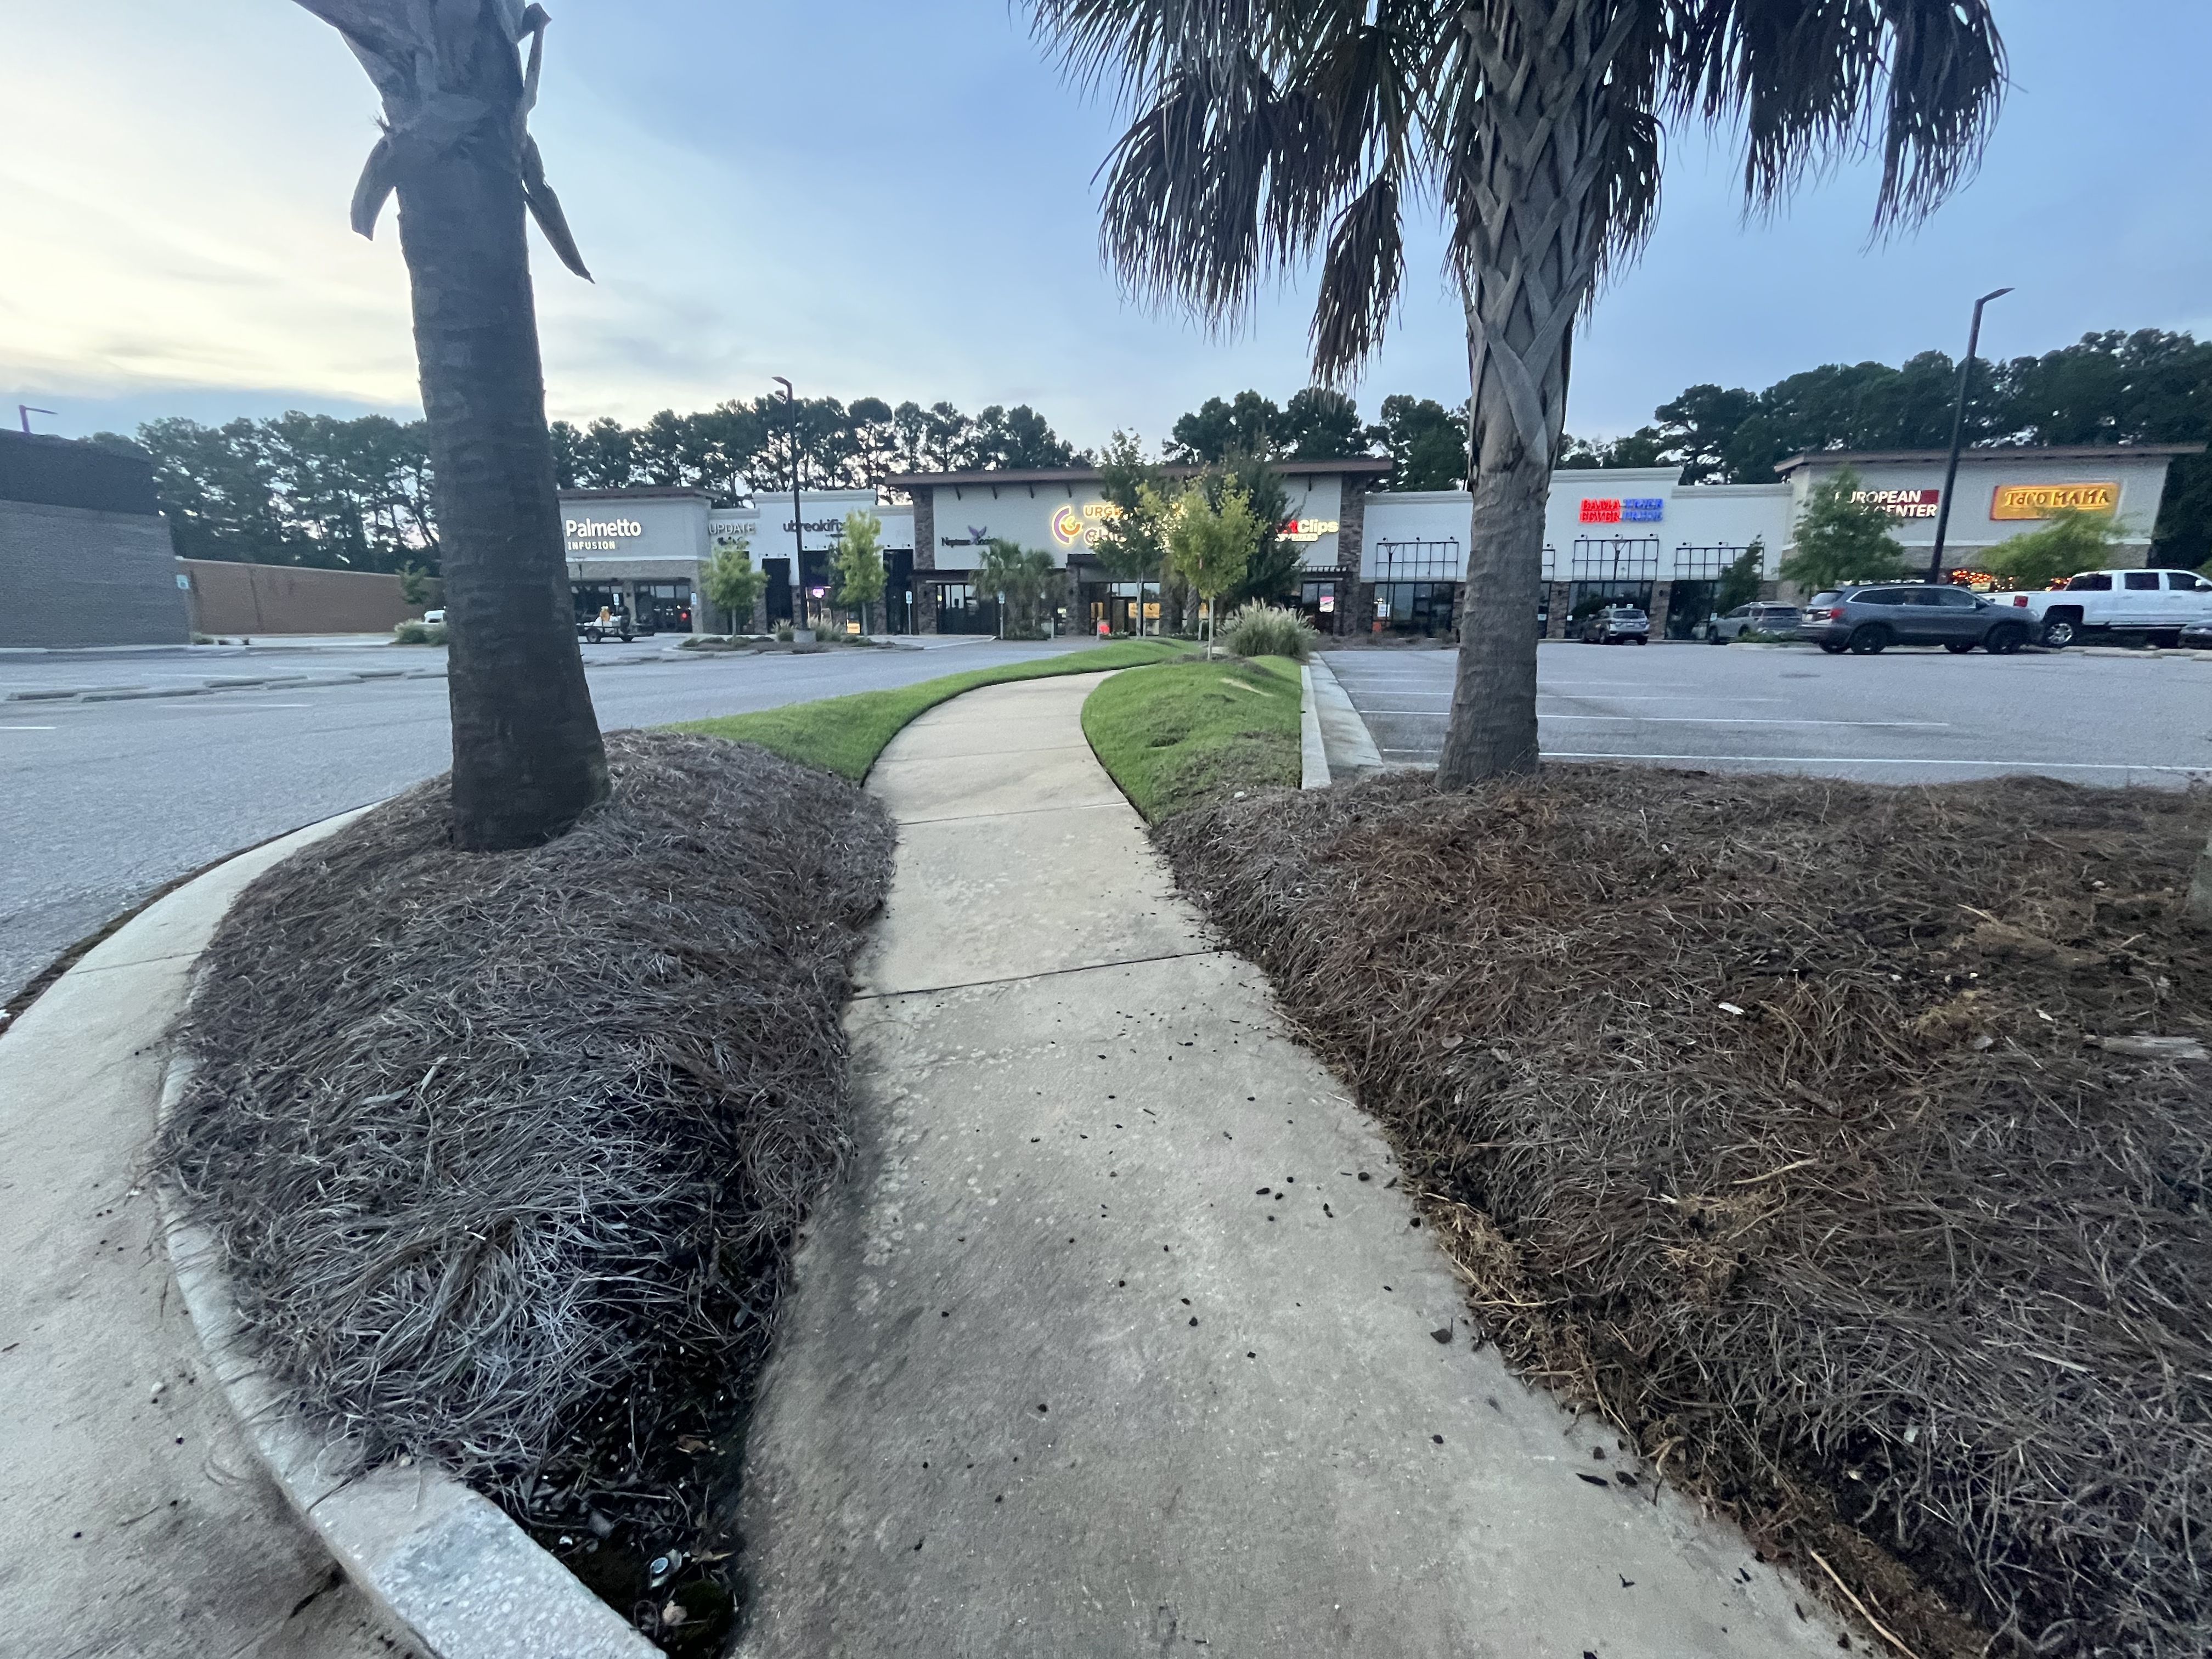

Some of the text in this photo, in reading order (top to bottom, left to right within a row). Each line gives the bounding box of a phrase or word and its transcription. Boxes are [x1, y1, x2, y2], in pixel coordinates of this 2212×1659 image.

[1581, 498, 1621, 510] BAMA
[1579, 511, 1621, 523] FEVER
[566, 517, 641, 538] Palmetto
[708, 523, 756, 535] UPDATE
[1298, 518, 1339, 536] Clips
[567, 541, 616, 550] INFUSION
